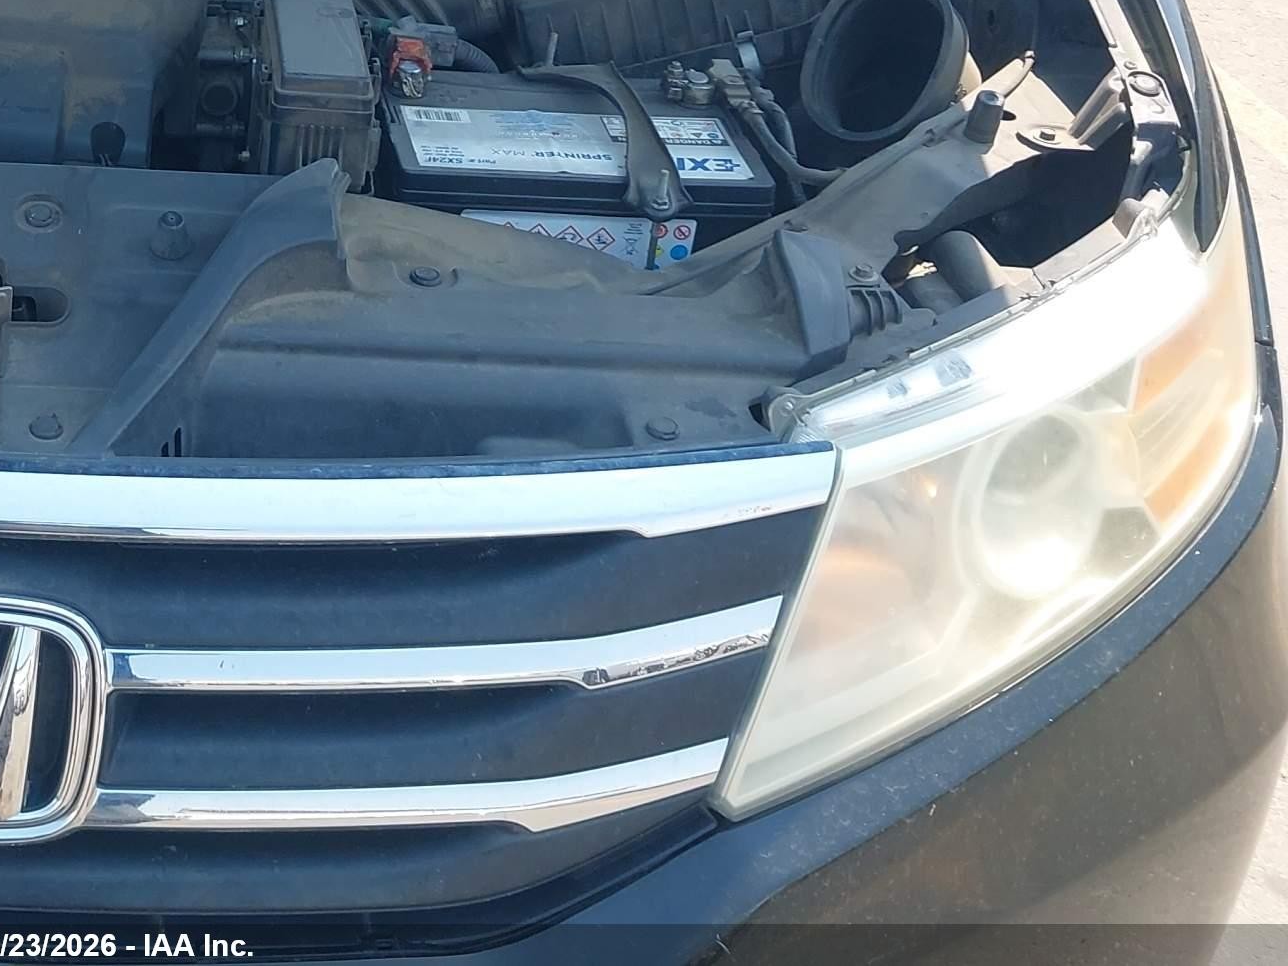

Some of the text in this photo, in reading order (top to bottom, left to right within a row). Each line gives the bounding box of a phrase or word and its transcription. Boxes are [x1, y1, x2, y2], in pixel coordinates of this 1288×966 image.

[491, 148, 613, 161] SPRINTER MAX
[675, 157, 741, 172] EXI
